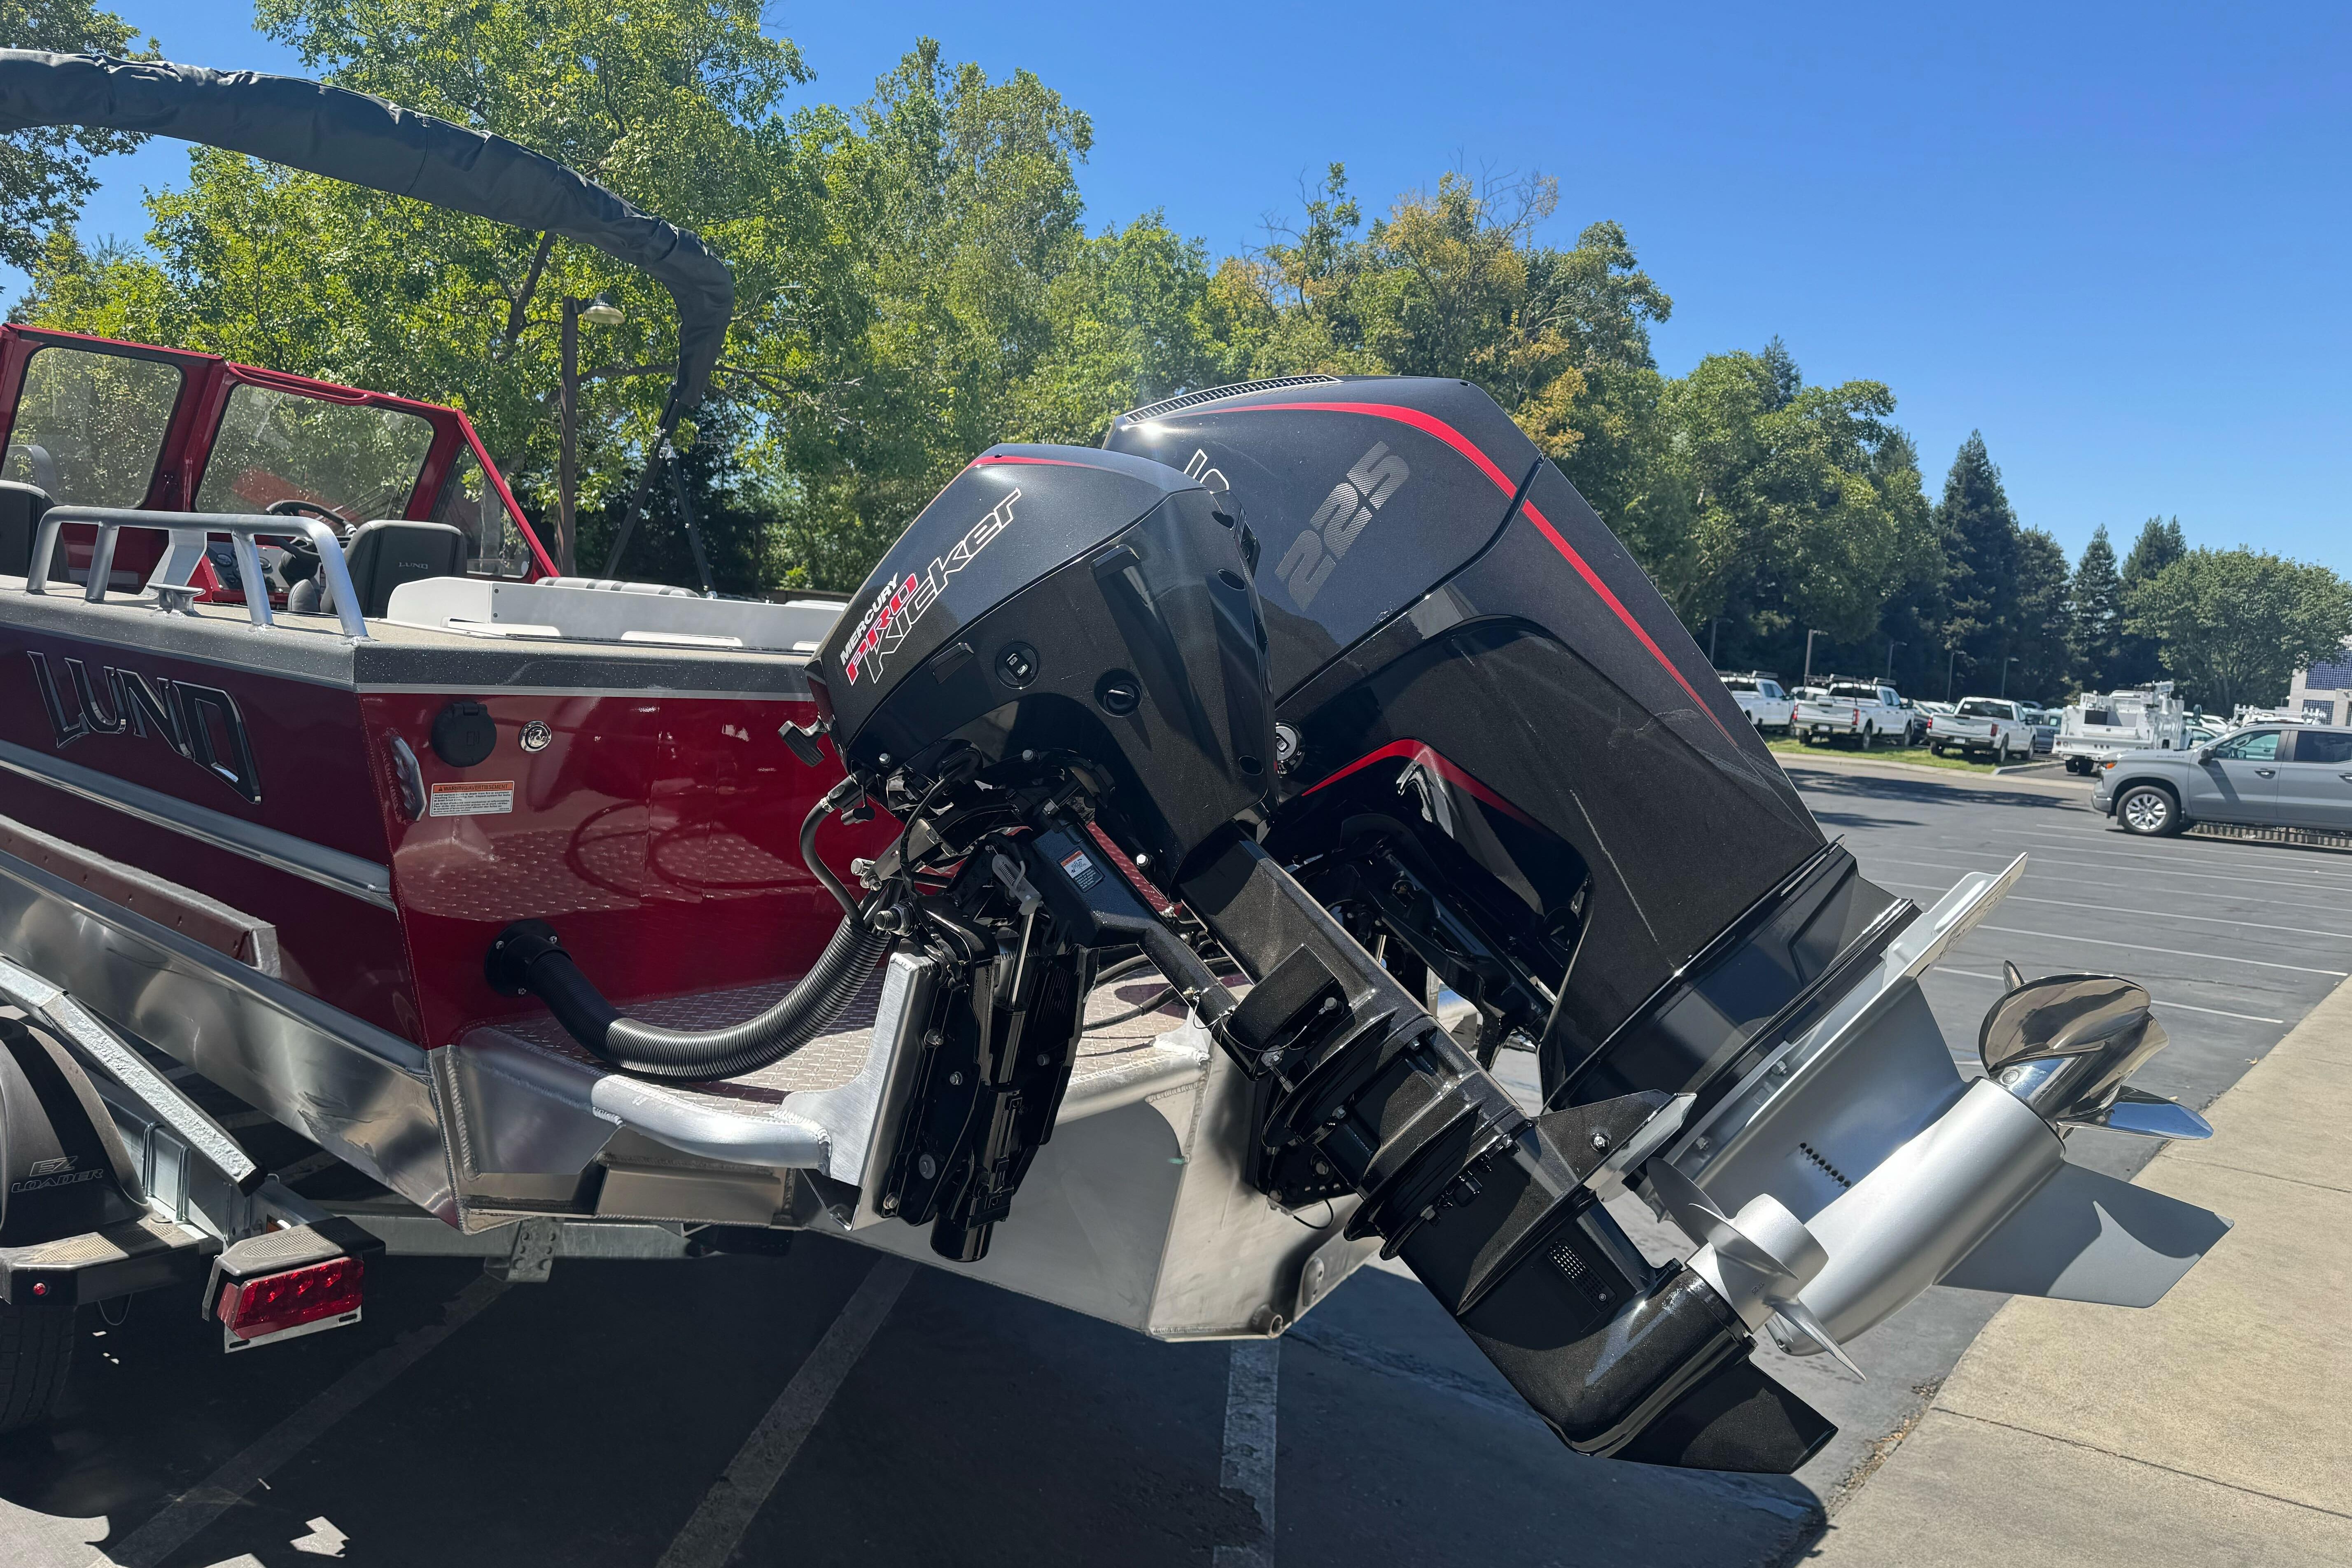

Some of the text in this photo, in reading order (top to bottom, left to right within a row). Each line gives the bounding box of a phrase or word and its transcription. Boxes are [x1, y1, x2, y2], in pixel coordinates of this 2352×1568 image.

[1275, 441, 1410, 612] 225
[840, 572, 899, 666] MERCURY
[845, 572, 919, 686] PRO
[27, 651, 261, 805] LUND
[12, 1169, 103, 1193] LOADER
[29, 1155, 78, 1177] EZ
